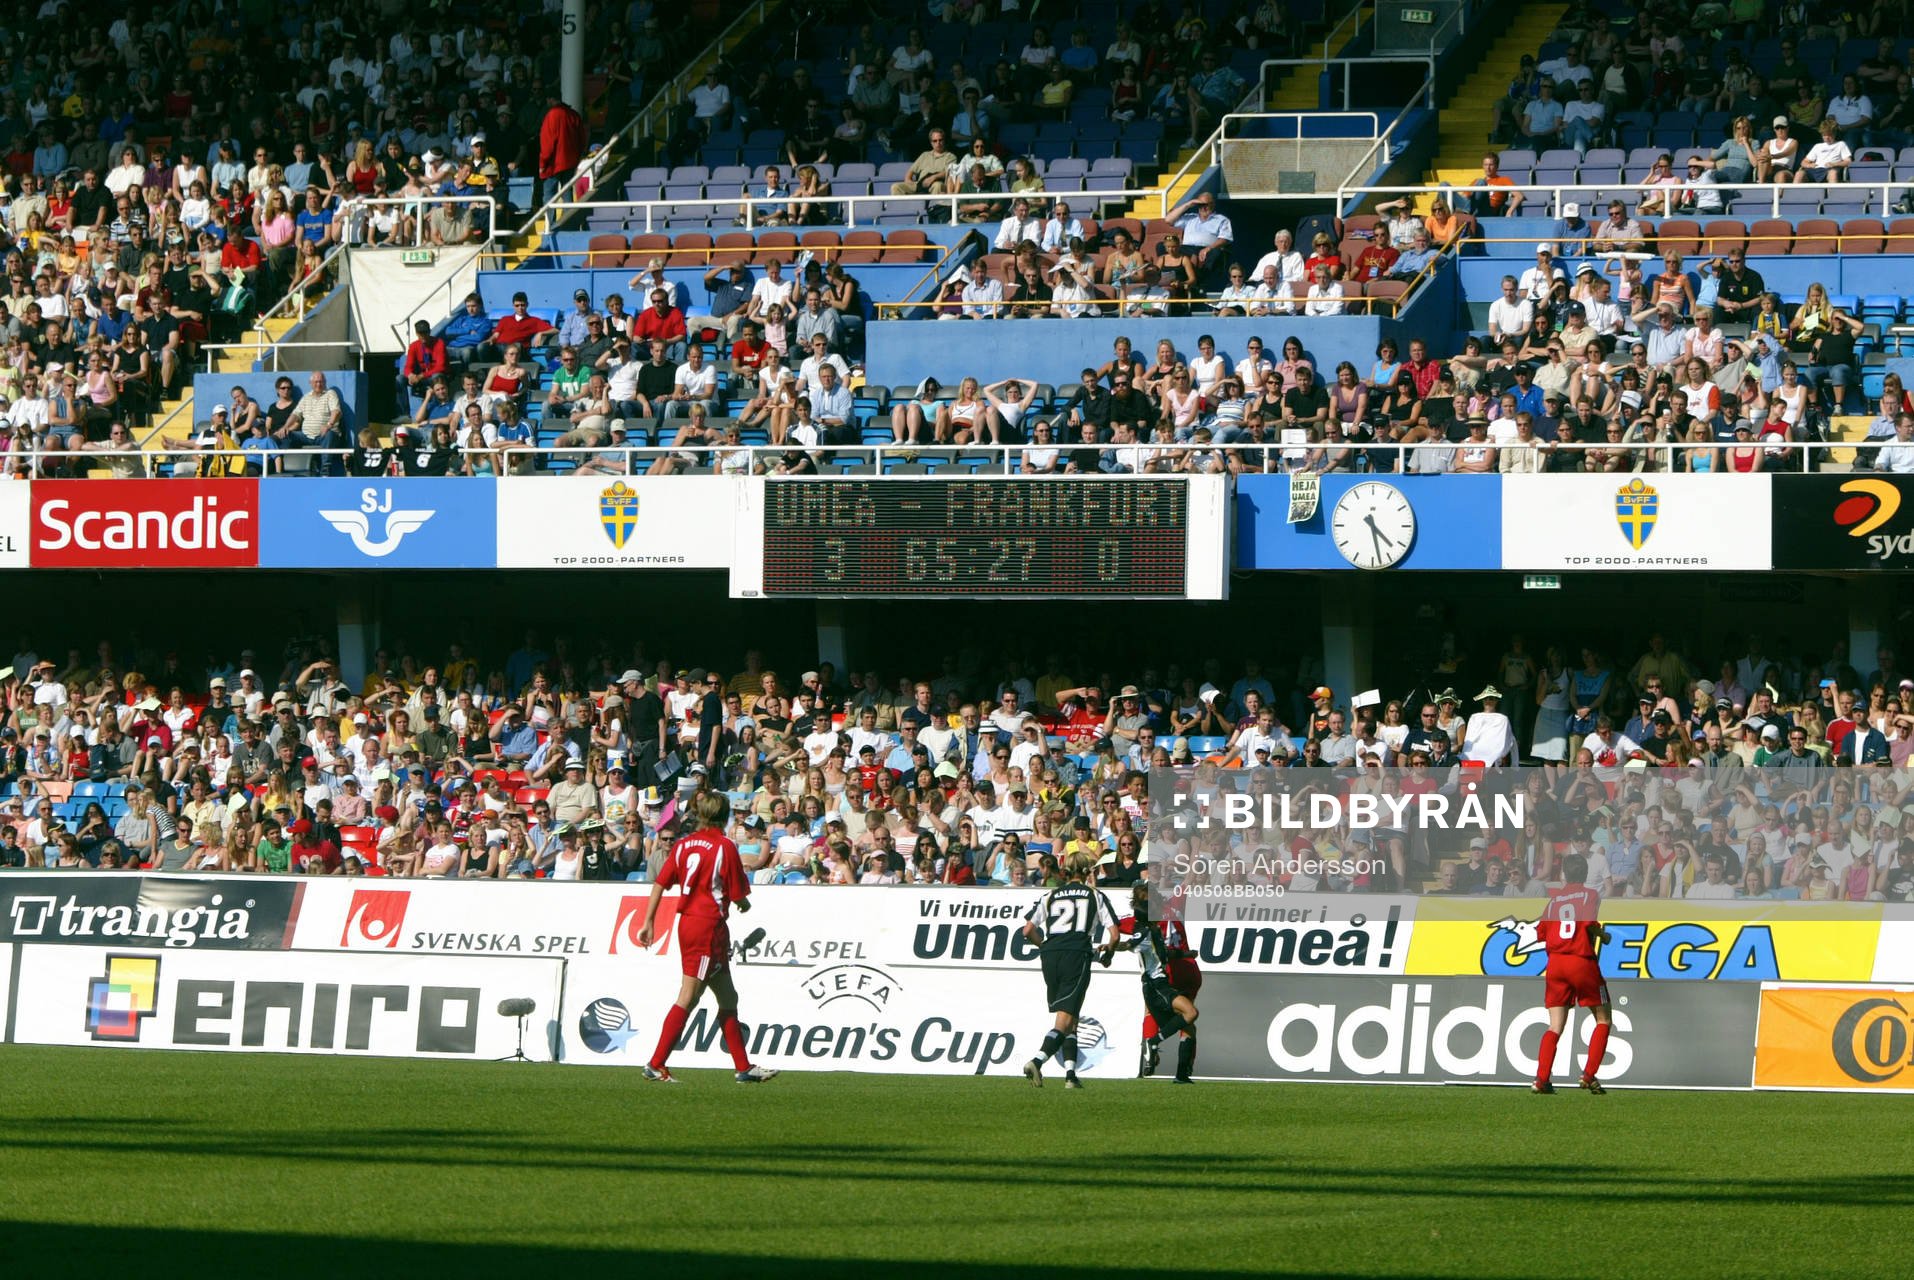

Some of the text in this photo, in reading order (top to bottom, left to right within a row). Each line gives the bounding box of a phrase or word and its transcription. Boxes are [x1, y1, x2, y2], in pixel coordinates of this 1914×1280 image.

[563, 14, 576, 35] 5
[361, 487, 392, 513] SJ
[947, 482, 1184, 526] FRANKFURT
[1292, 481, 1316, 491] HEJA
[39, 496, 249, 550] Scandic
[554, 556, 685, 564] TOP 2000-PARTNERS
[825, 537, 1119, 580] 3 65:27 0
[1565, 556, 1708, 565] TOP 2000-PARTNERS
[682, 852, 701, 896] 2
[920, 899, 941, 918] Vi
[949, 901, 1024, 919] vinner
[1049, 898, 1089, 935] 21
[1205, 902, 1228, 923] Vi
[1235, 904, 1311, 924] vinner
[1559, 903, 1576, 940] 8
[412, 931, 590, 955] SVENSKA SPEL
[808, 941, 867, 959] SPEL
[1200, 904, 1402, 967] umeå!
[1480, 922, 1780, 980] OEGA
[808, 973, 890, 1004] UEFA
[172, 979, 481, 1054] eniro
[1267, 983, 1633, 1080] adidas
[911, 1017, 1015, 1075] Cup
